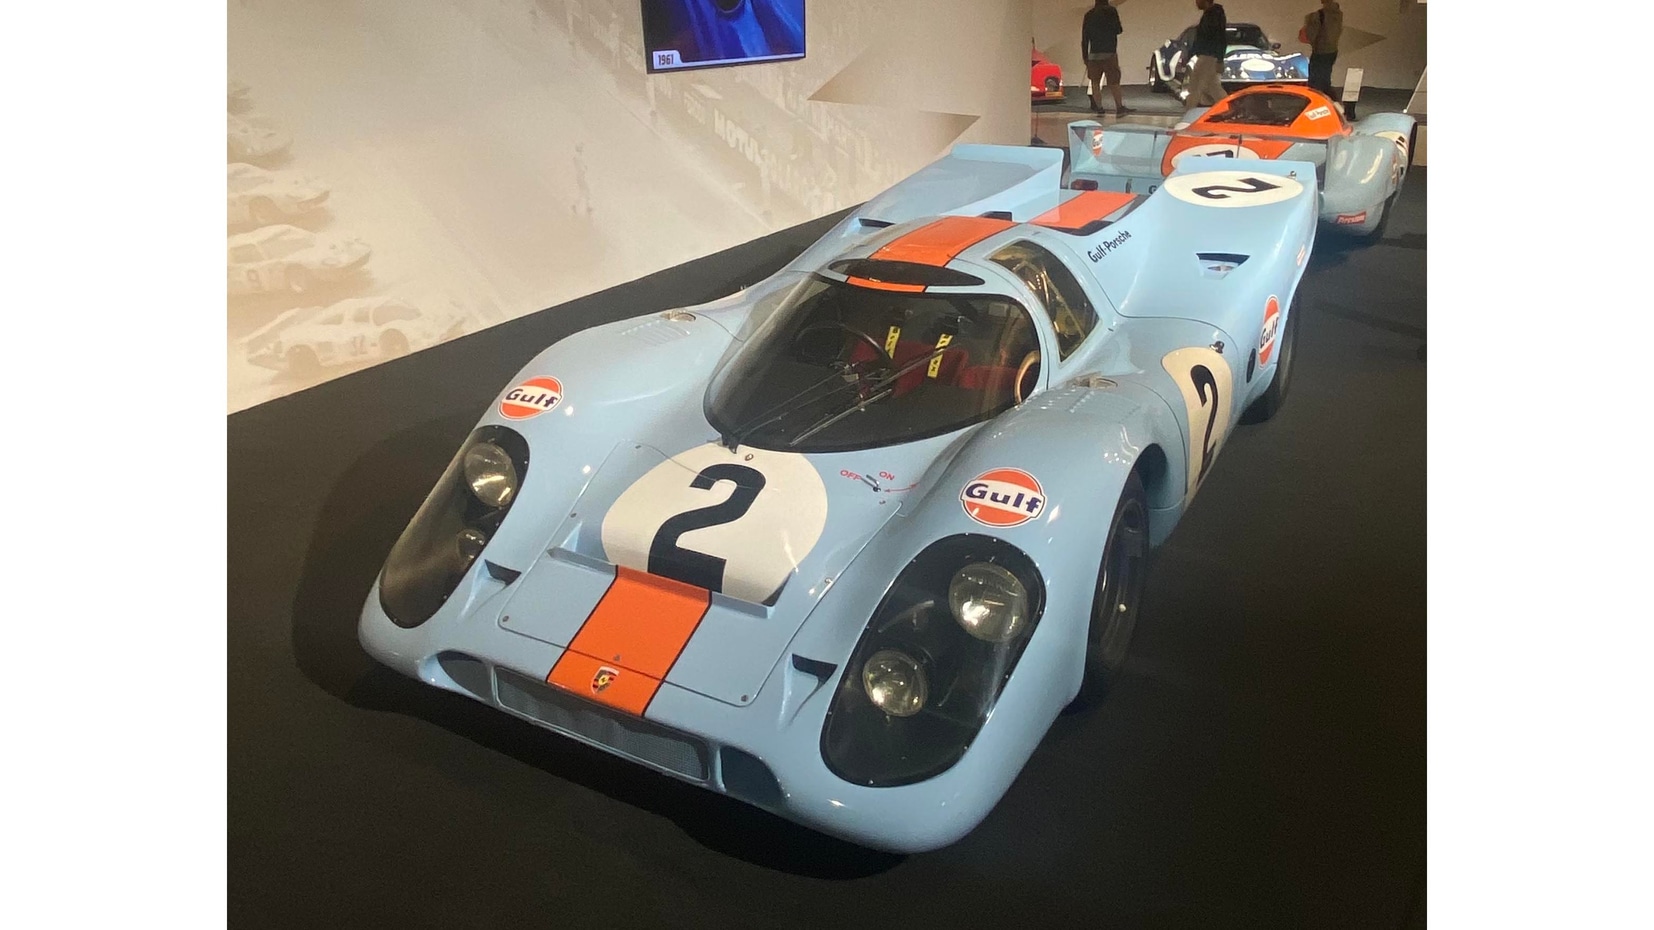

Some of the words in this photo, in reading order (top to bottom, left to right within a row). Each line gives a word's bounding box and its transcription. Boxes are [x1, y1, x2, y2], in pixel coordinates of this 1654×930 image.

[658, 54, 674, 66] 1961
[1191, 177, 1282, 200] 2
[1260, 316, 1279, 349] Gulf
[505, 388, 559, 408] Gulf
[1190, 364, 1219, 491] 2
[840, 469, 862, 481] OFF
[879, 471, 896, 481] ON
[965, 482, 1042, 514] Gulf
[647, 463, 767, 594] 2
